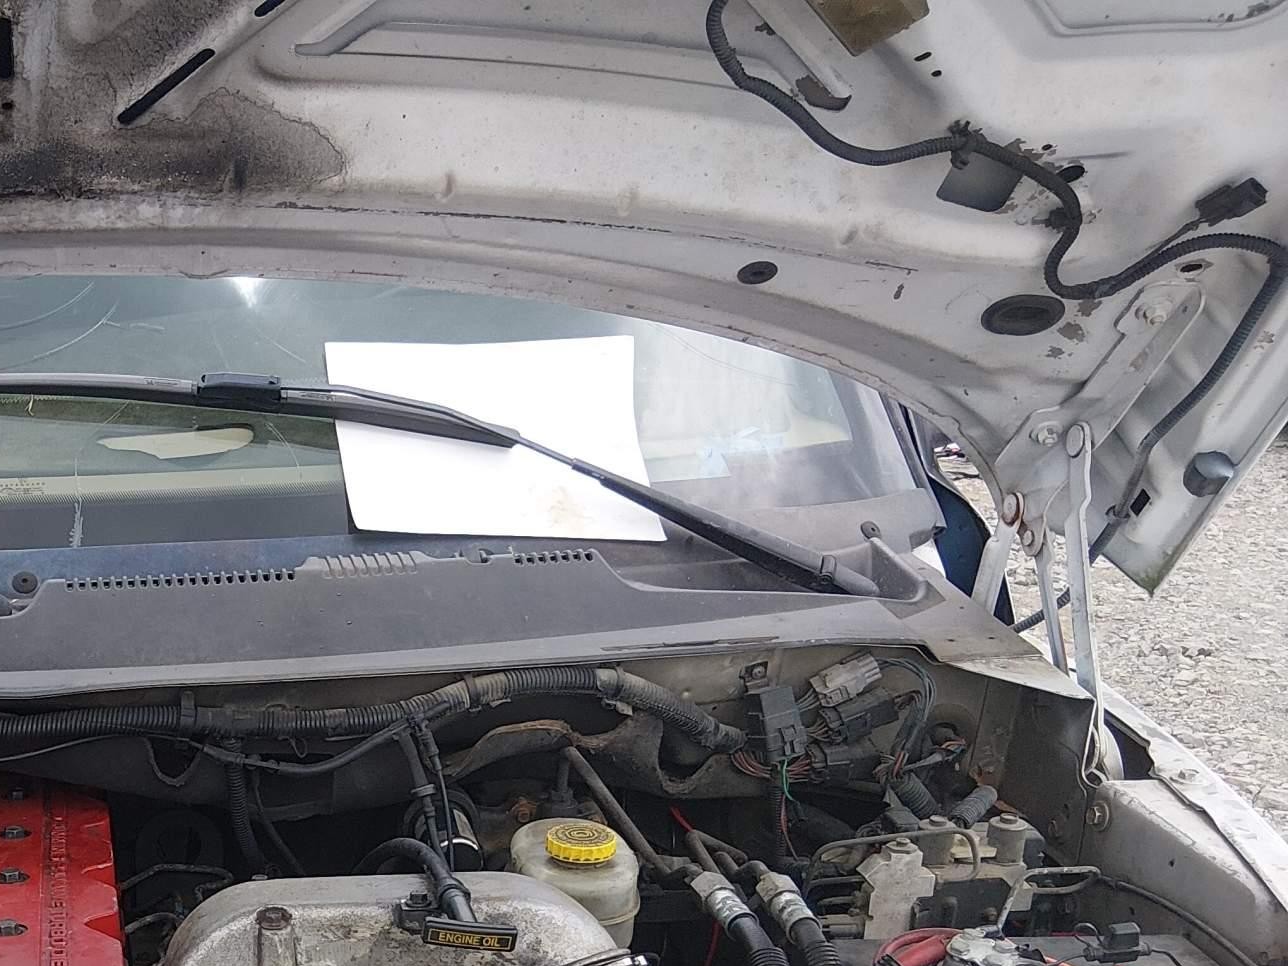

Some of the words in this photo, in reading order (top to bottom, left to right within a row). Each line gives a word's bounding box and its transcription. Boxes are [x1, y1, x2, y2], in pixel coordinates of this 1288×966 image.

[49, 910, 68, 945] TURBO
[438, 932, 481, 945] ENGINE
[482, 938, 501, 947] OIL
